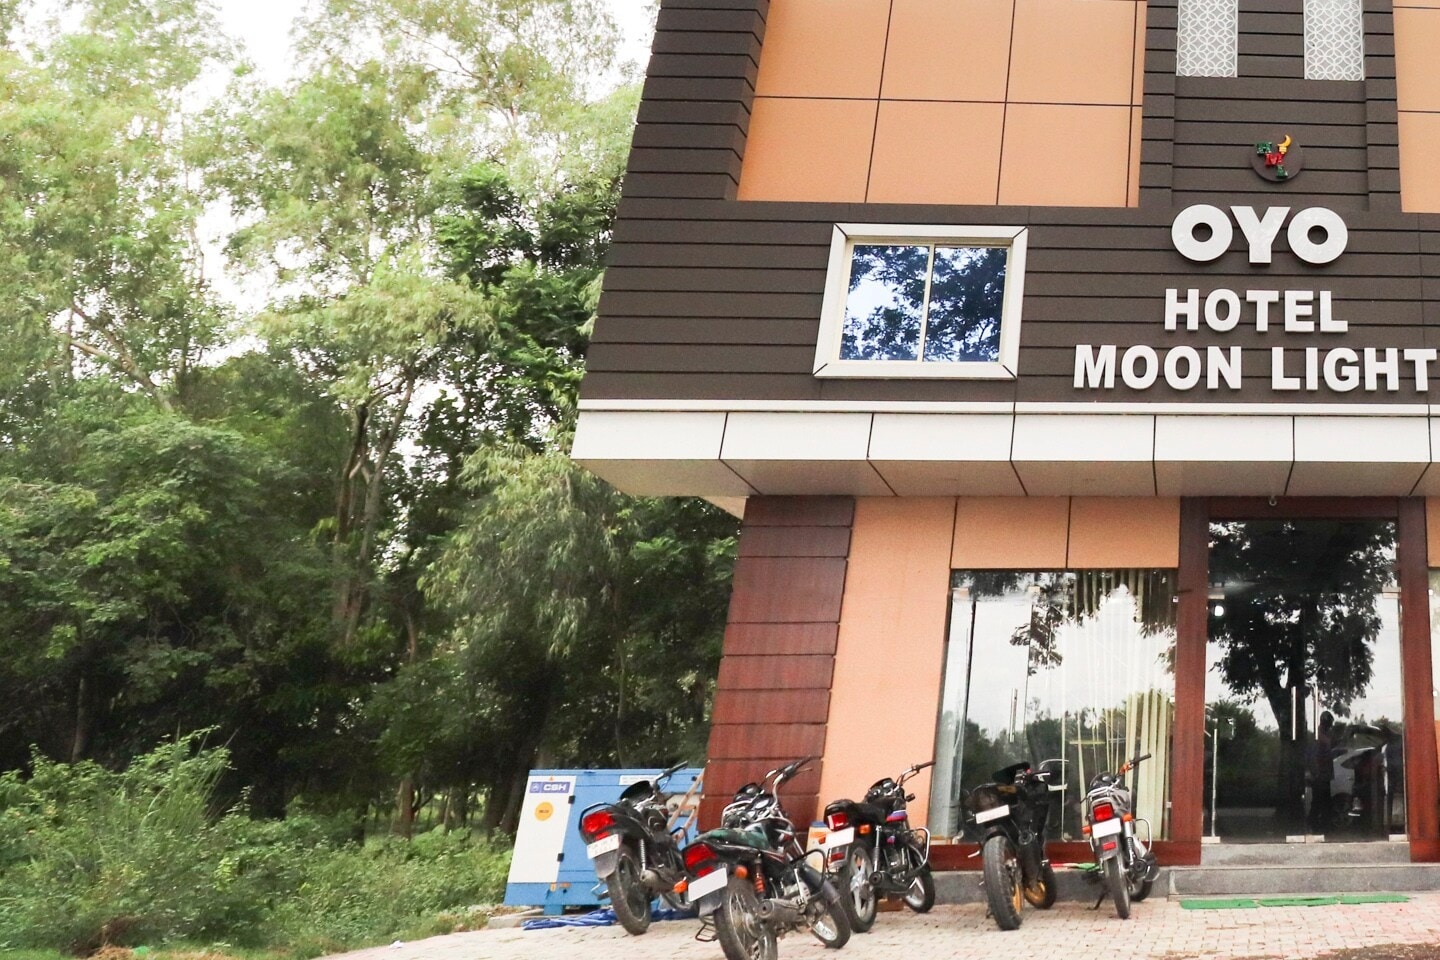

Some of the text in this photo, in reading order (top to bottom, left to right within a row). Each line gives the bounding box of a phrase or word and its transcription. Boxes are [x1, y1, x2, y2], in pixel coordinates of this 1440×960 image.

[1171, 204, 1349, 265] OYO
[1163, 288, 1349, 334] HOTEL
[1073, 344, 1438, 393] MOON LIGHT
